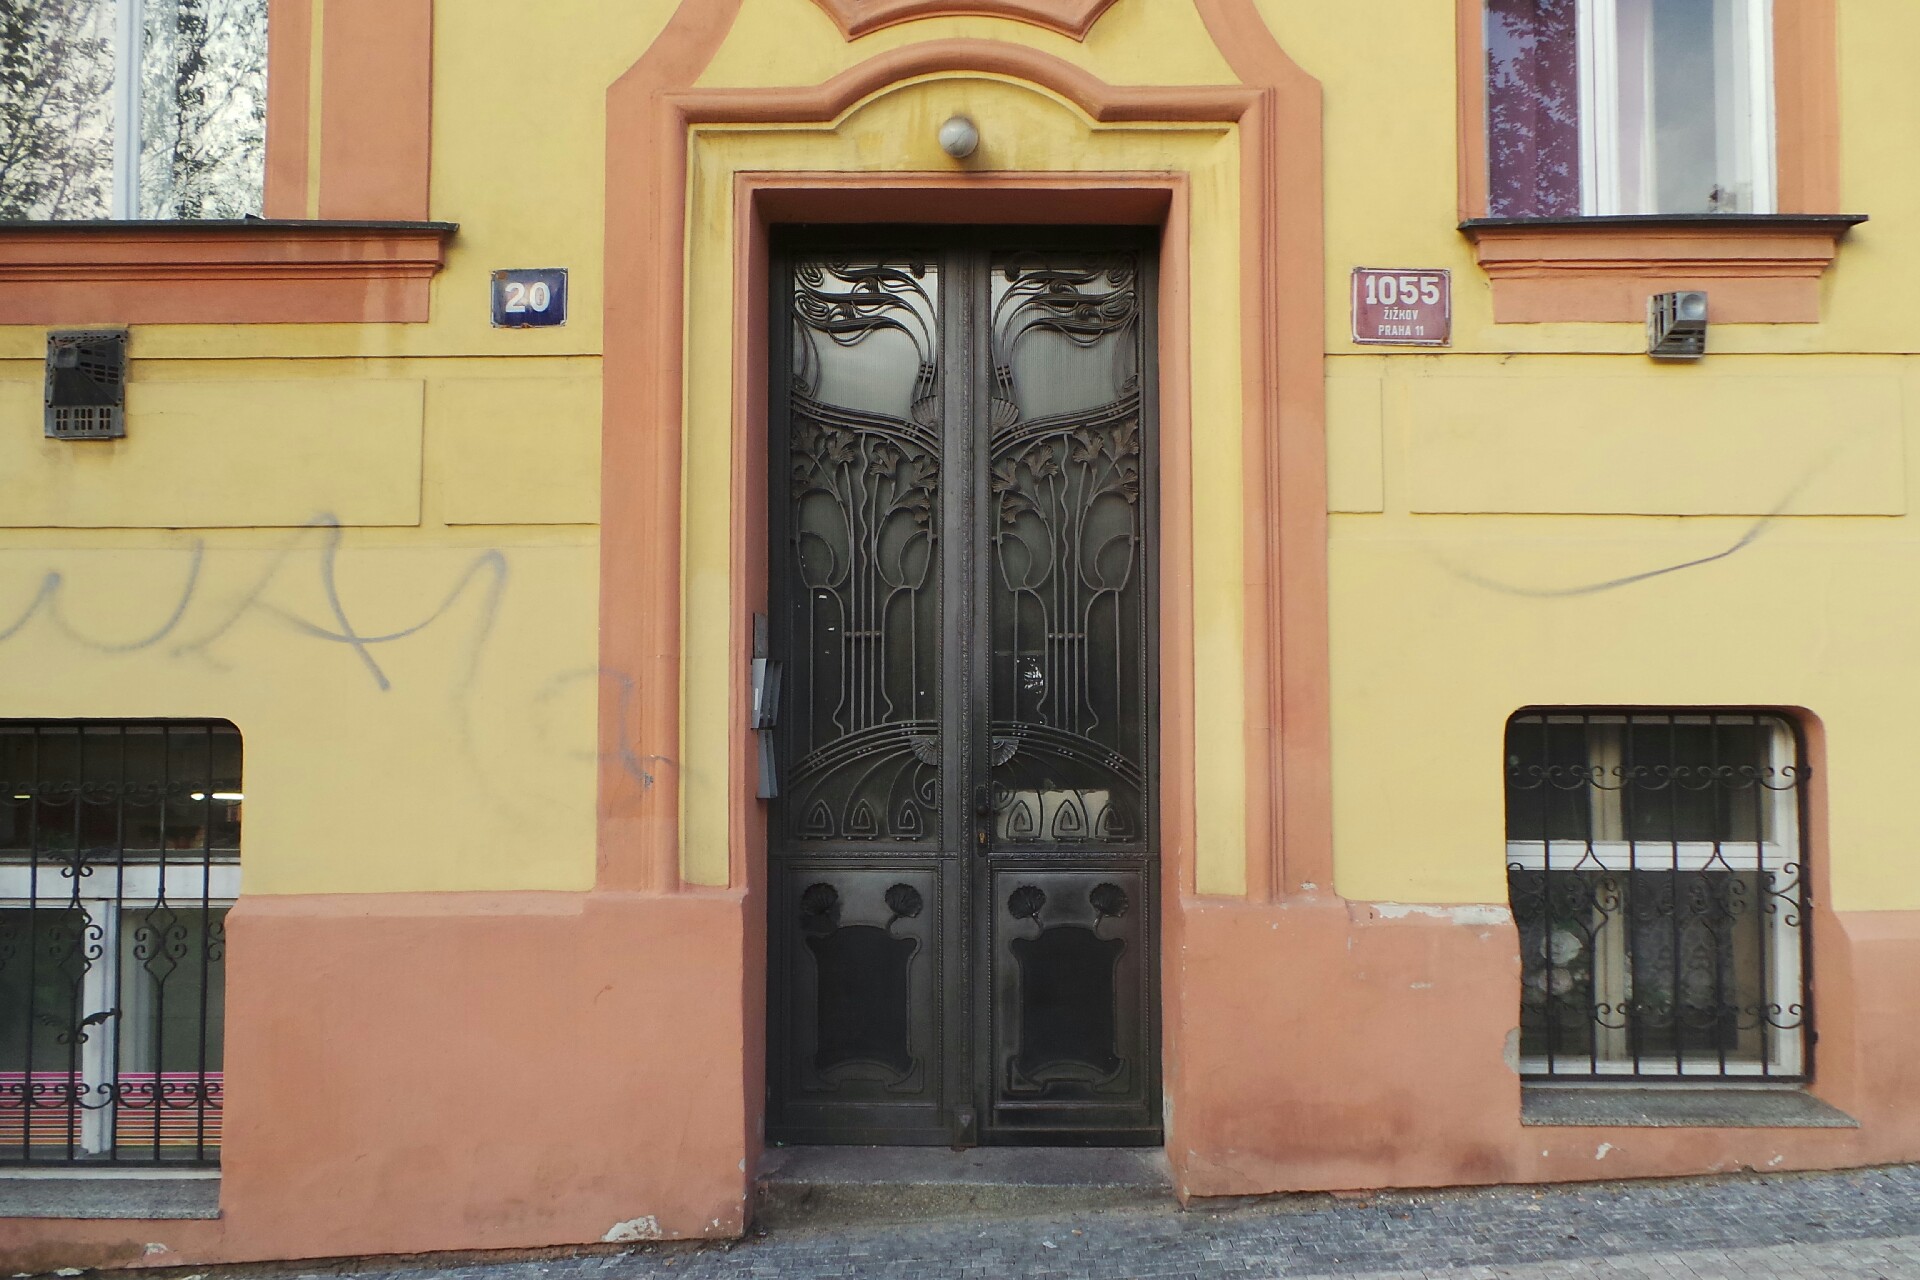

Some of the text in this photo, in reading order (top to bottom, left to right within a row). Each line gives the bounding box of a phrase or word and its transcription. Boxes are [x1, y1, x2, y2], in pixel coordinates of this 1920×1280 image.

[504, 281, 551, 313] 20
[1365, 275, 1440, 305] 1055
[1383, 306, 1419, 320] ŽIŽKOV
[1378, 325, 1424, 336] PRAHA 11
